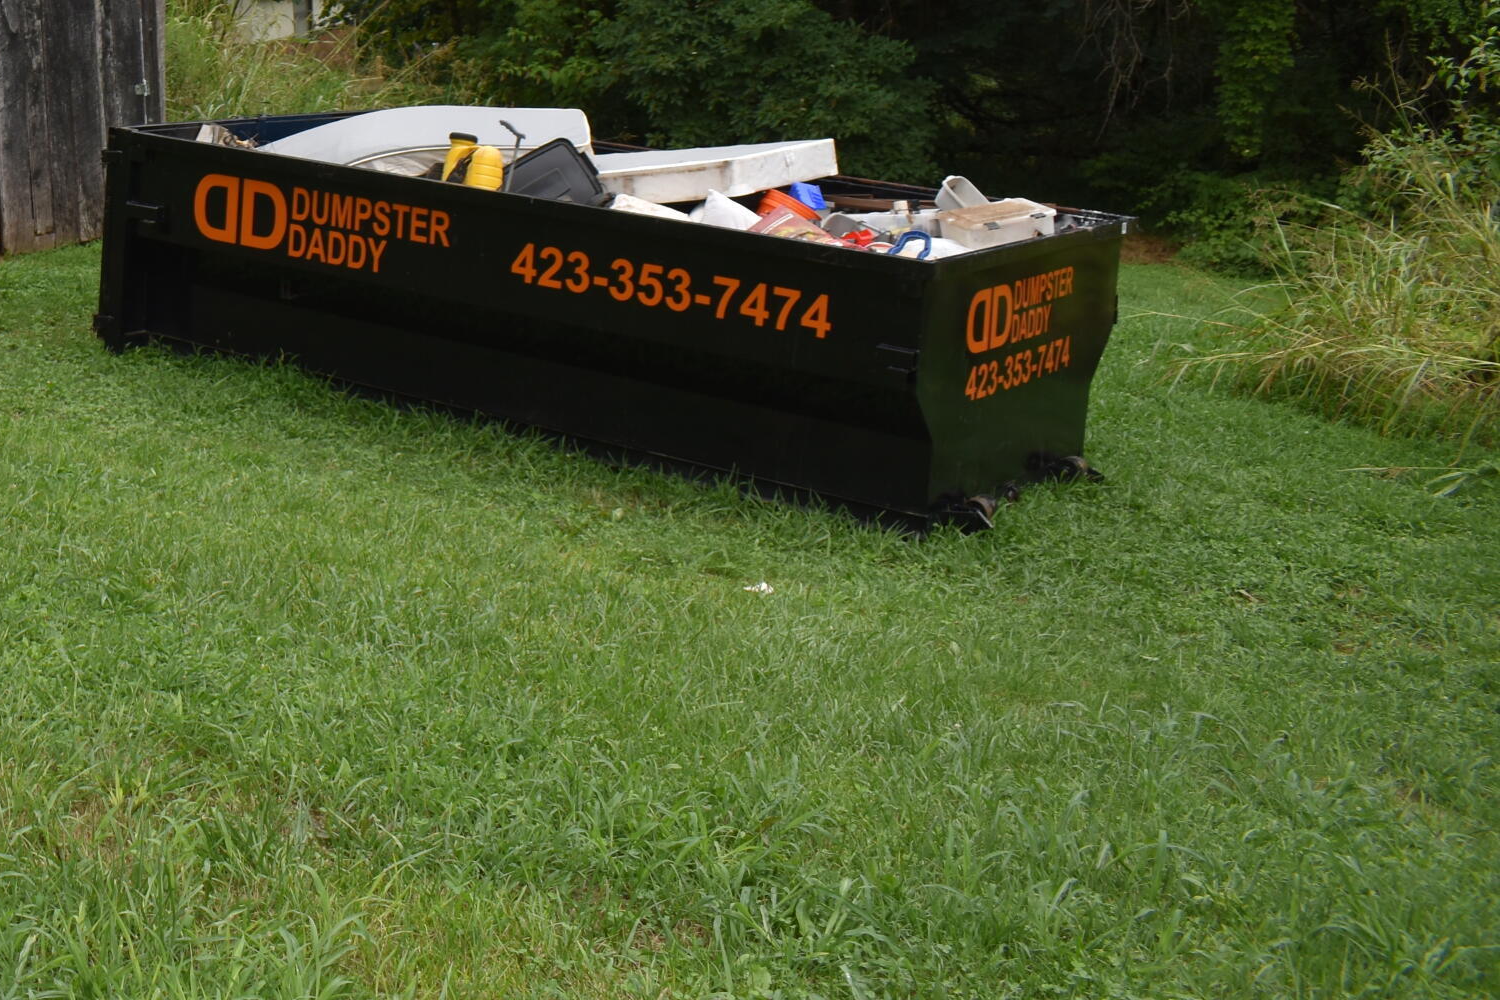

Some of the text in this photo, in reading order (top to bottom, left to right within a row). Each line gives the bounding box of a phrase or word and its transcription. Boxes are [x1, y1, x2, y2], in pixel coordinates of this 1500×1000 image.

[292, 186, 451, 248] DUMPSTER
[288, 223, 388, 273] DADDY
[510, 242, 833, 339] 423-353-7474
[1014, 265, 1074, 311] DUMPSTER
[1011, 305, 1053, 344] DADDY
[964, 335, 1071, 401] 423-353-7474
